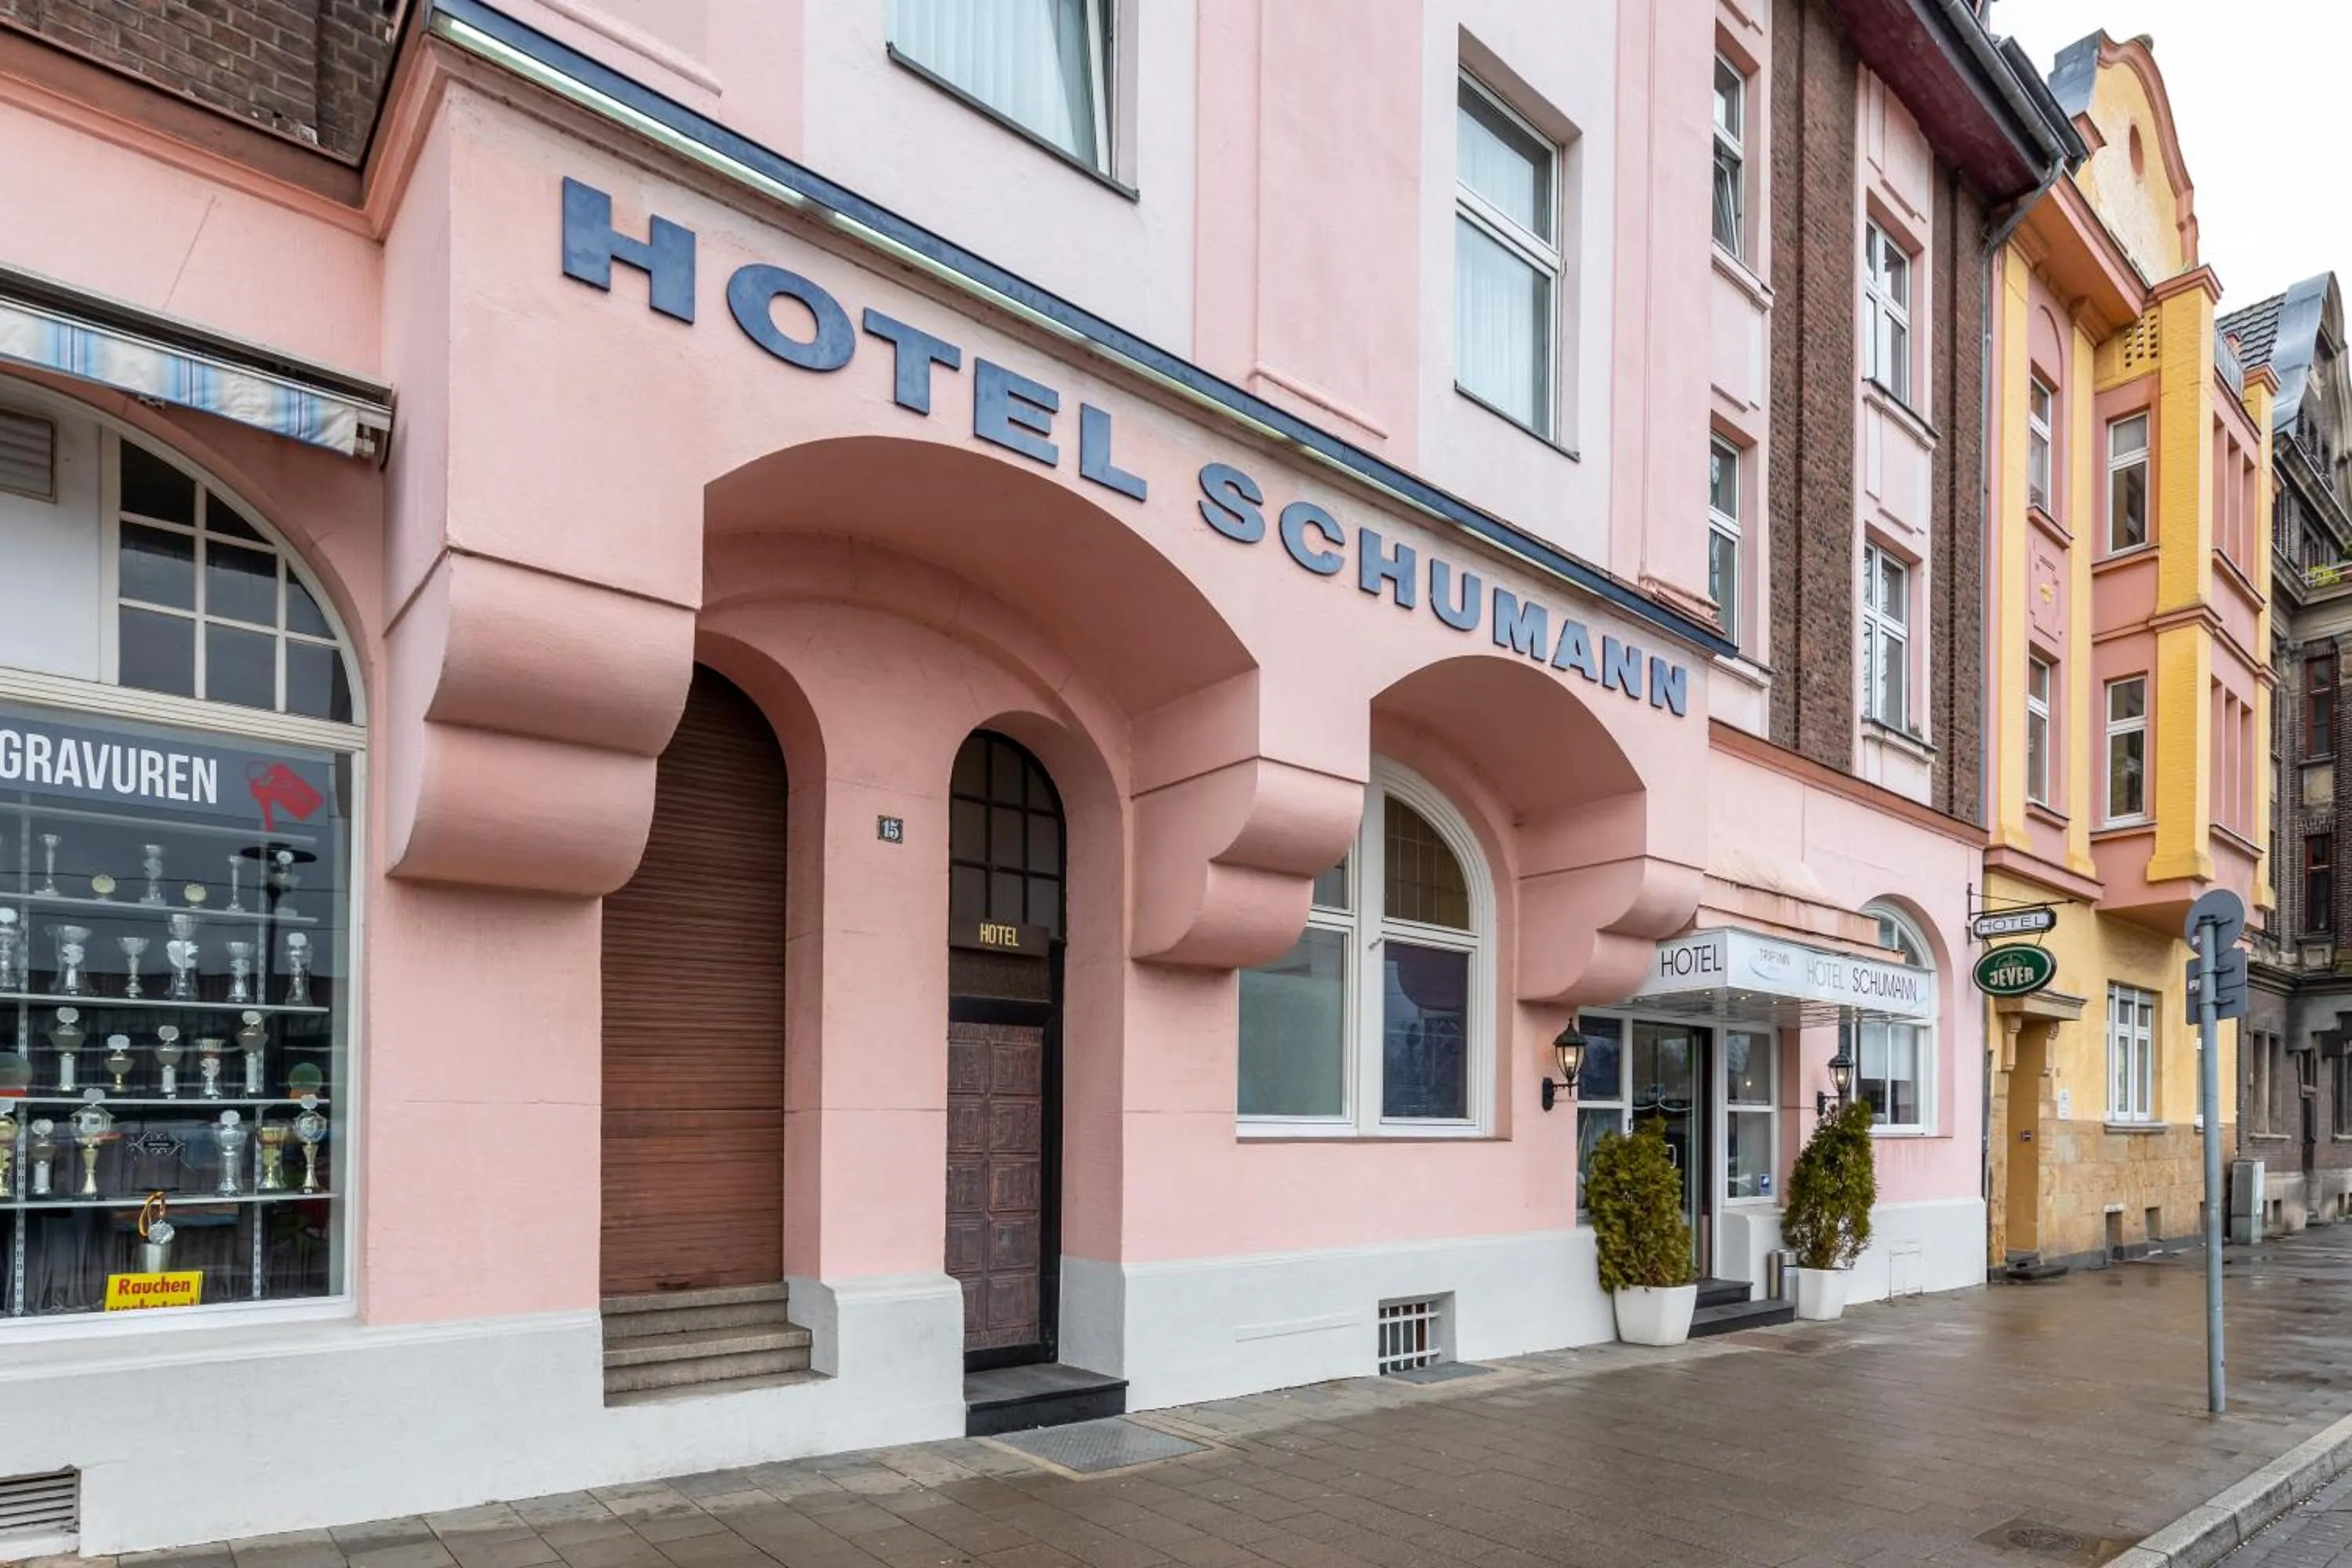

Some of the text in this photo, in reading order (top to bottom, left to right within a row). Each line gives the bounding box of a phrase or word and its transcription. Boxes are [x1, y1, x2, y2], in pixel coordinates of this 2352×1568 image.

[562, 176, 1688, 717] HOTEL SCHUMANN
[0, 730, 217, 804] GRAVUREN
[883, 820, 899, 839] 15
[980, 922, 1019, 947] HOTEL
[1980, 915, 2045, 931] HOTEL
[1661, 943, 1722, 978] HOTEL
[1806, 958, 1918, 1002] HOTEL SCHUMANN
[1989, 967, 2034, 987] JEVER
[118, 1276, 191, 1295] Rauchen
